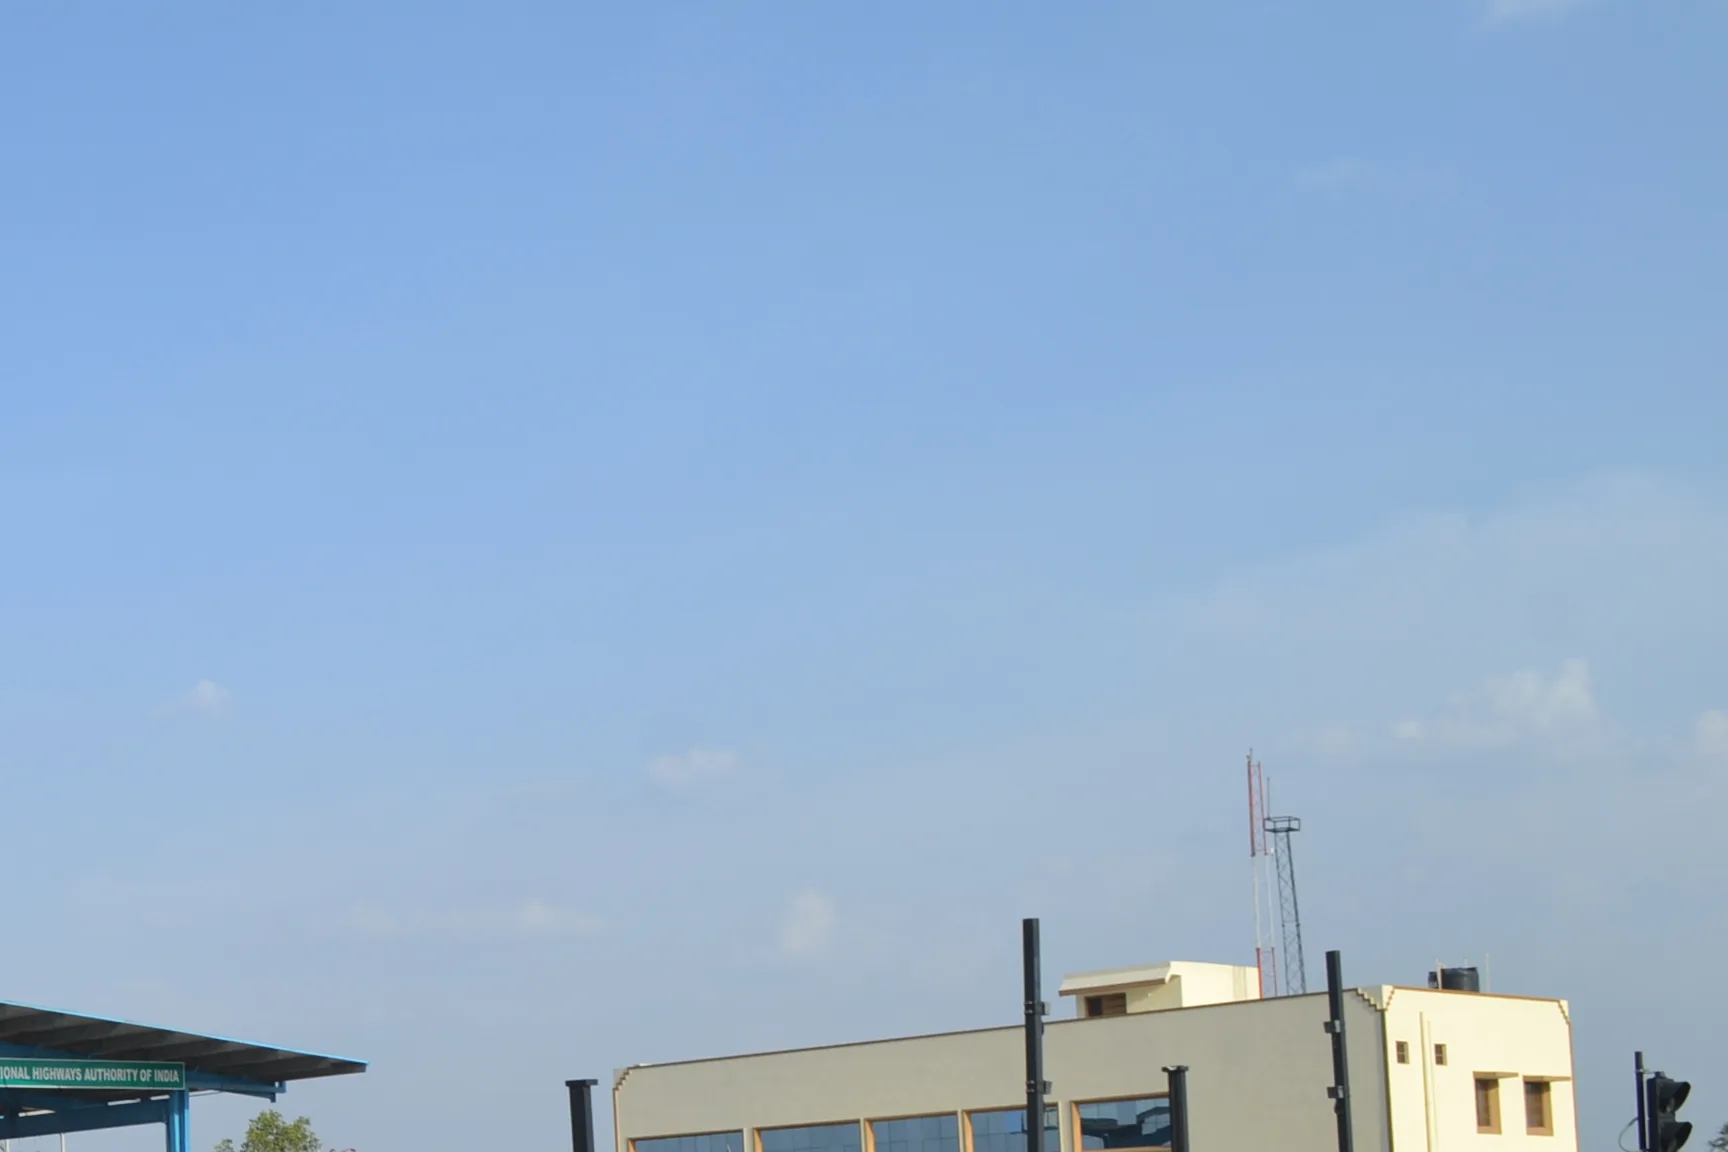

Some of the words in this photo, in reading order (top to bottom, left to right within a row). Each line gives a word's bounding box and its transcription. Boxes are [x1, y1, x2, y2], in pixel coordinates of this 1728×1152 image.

[32, 1066, 82, 1082] HIGHWAYS
[84, 1068, 139, 1083] AUTHORITY
[139, 1069, 152, 1082] OF
[154, 1069, 180, 1083] INDIA
